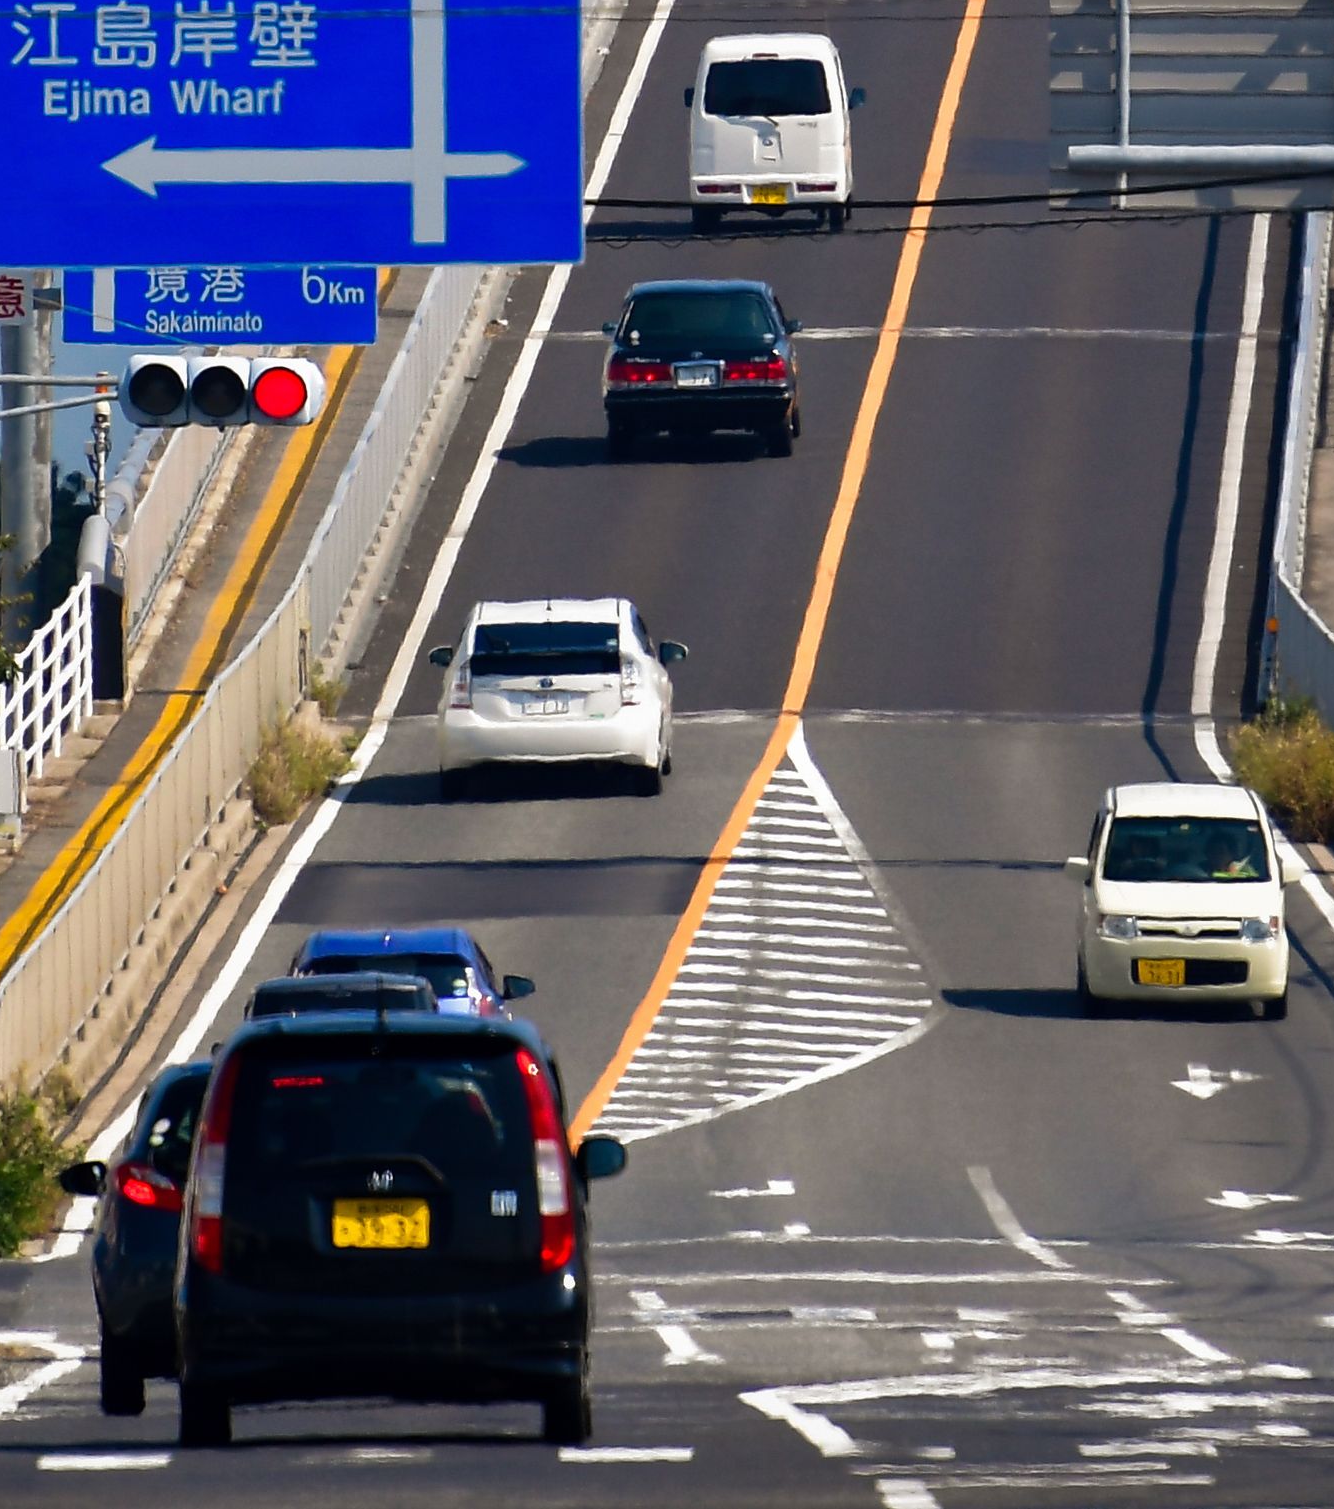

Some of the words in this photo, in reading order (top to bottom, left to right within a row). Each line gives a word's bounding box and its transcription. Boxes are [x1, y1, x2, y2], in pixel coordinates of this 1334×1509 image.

[11, 0, 319, 68] 江島岸壁
[43, 80, 151, 121] Ejima
[171, 80, 285, 115] Wharf
[145, 268, 245, 303] 境港
[145, 309, 263, 334] Sakaiminato
